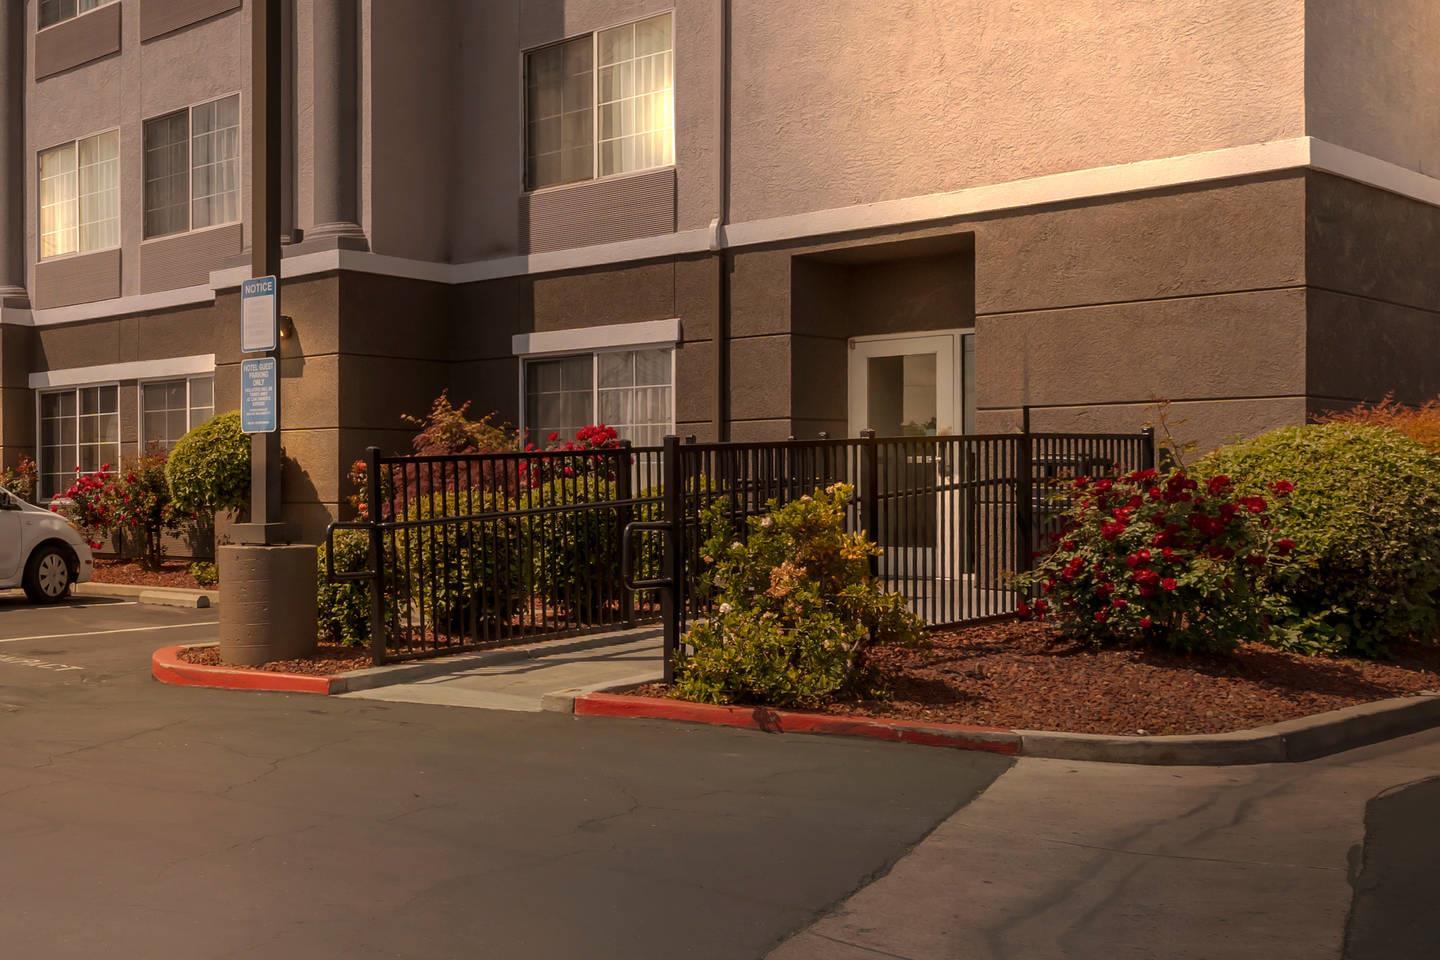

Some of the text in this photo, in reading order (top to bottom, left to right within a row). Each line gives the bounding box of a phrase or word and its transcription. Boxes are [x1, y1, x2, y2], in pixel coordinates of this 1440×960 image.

[245, 281, 273, 295] NOTICE
[243, 363, 259, 372] HOTEL
[252, 379, 265, 387] ONLY
